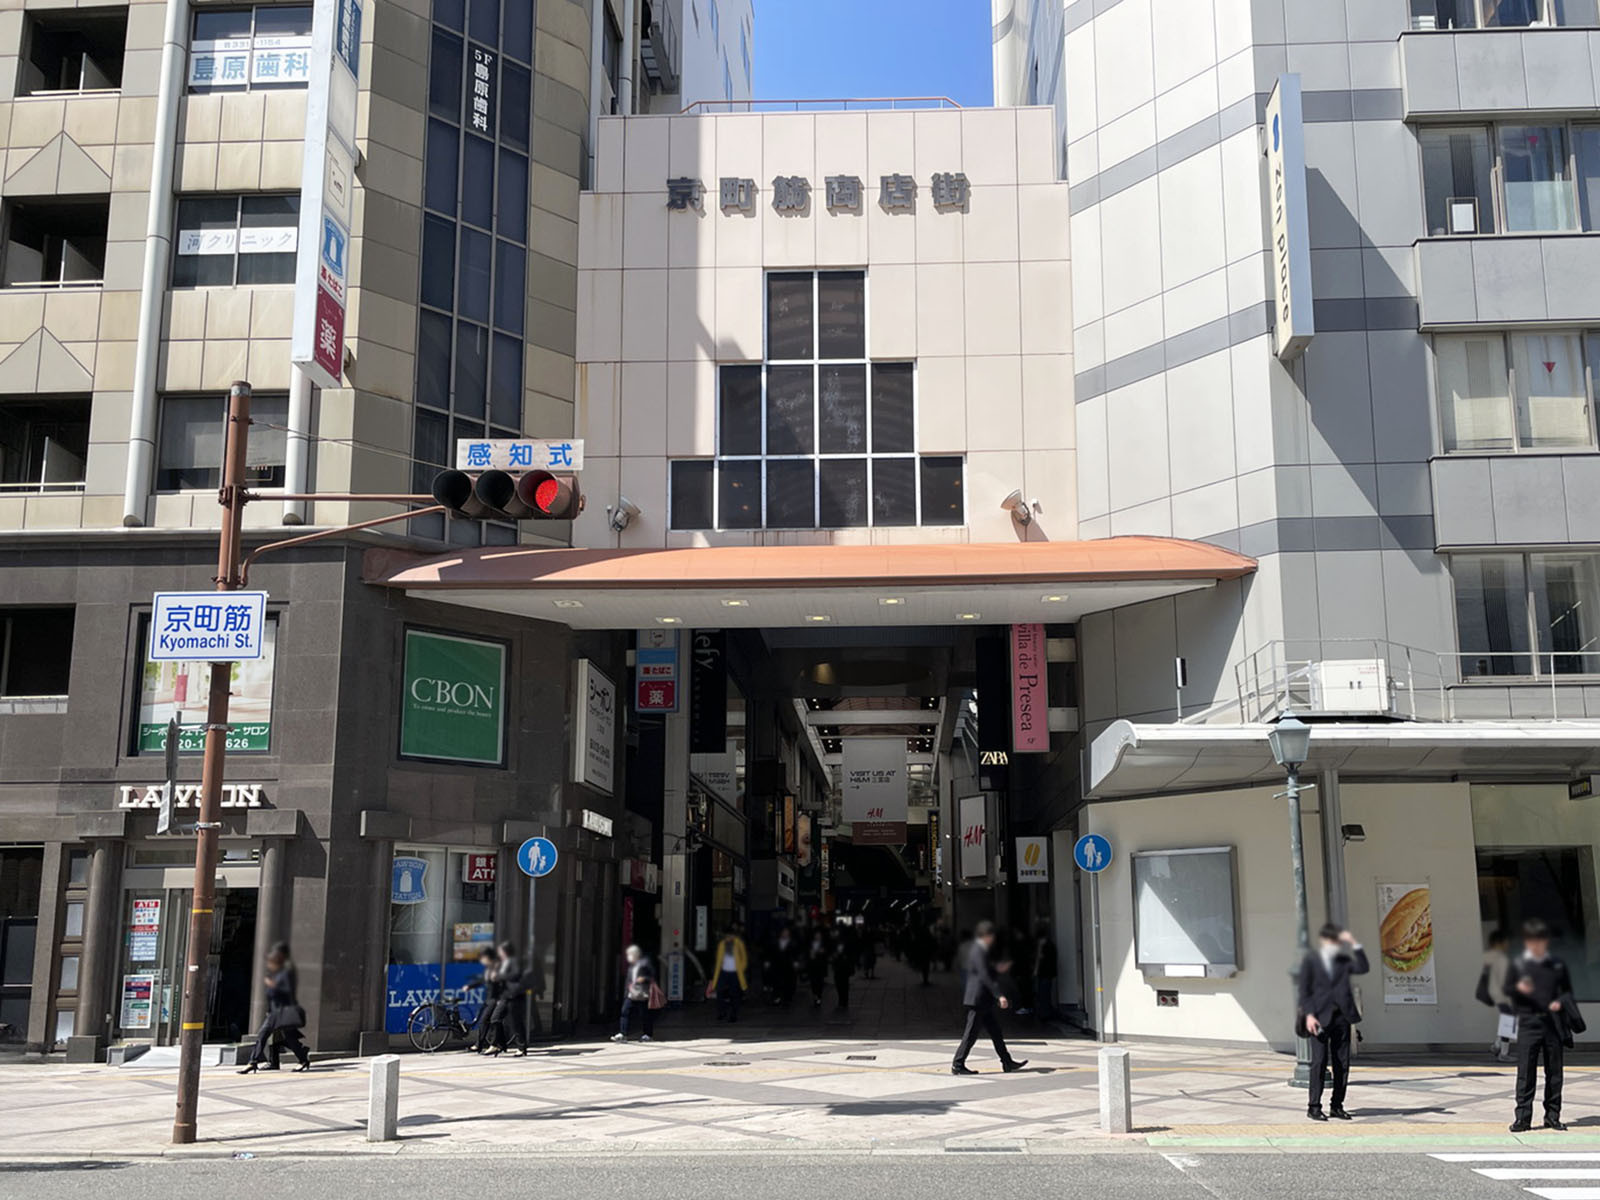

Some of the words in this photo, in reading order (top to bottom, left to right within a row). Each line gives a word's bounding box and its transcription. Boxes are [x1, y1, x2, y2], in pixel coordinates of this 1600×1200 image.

[193, 52, 308, 81] 島原歯科
[474, 49, 493, 65] 5F
[473, 62, 489, 132] 島原歯科
[666, 172, 967, 213] 京町筋商店街
[1275, 162, 1283, 225] zen
[1277, 233, 1290, 323] place
[320, 317, 337, 361] 薬
[467, 443, 572, 467] 感知式
[164, 604, 252, 633] 京町筋
[160, 633, 230, 651] Kyomachi
[234, 633, 253, 649] St.
[1018, 653, 1032, 669] de
[411, 676, 495, 710] C'BON
[649, 689, 664, 705] 薬
[1019, 674, 1038, 731] Presea
[243, 726, 269, 735] サロン
[980, 751, 1009, 766] ZARA
[1387, 975, 1431, 983] てりやきチキン
[388, 988, 485, 1008] LAWSON
